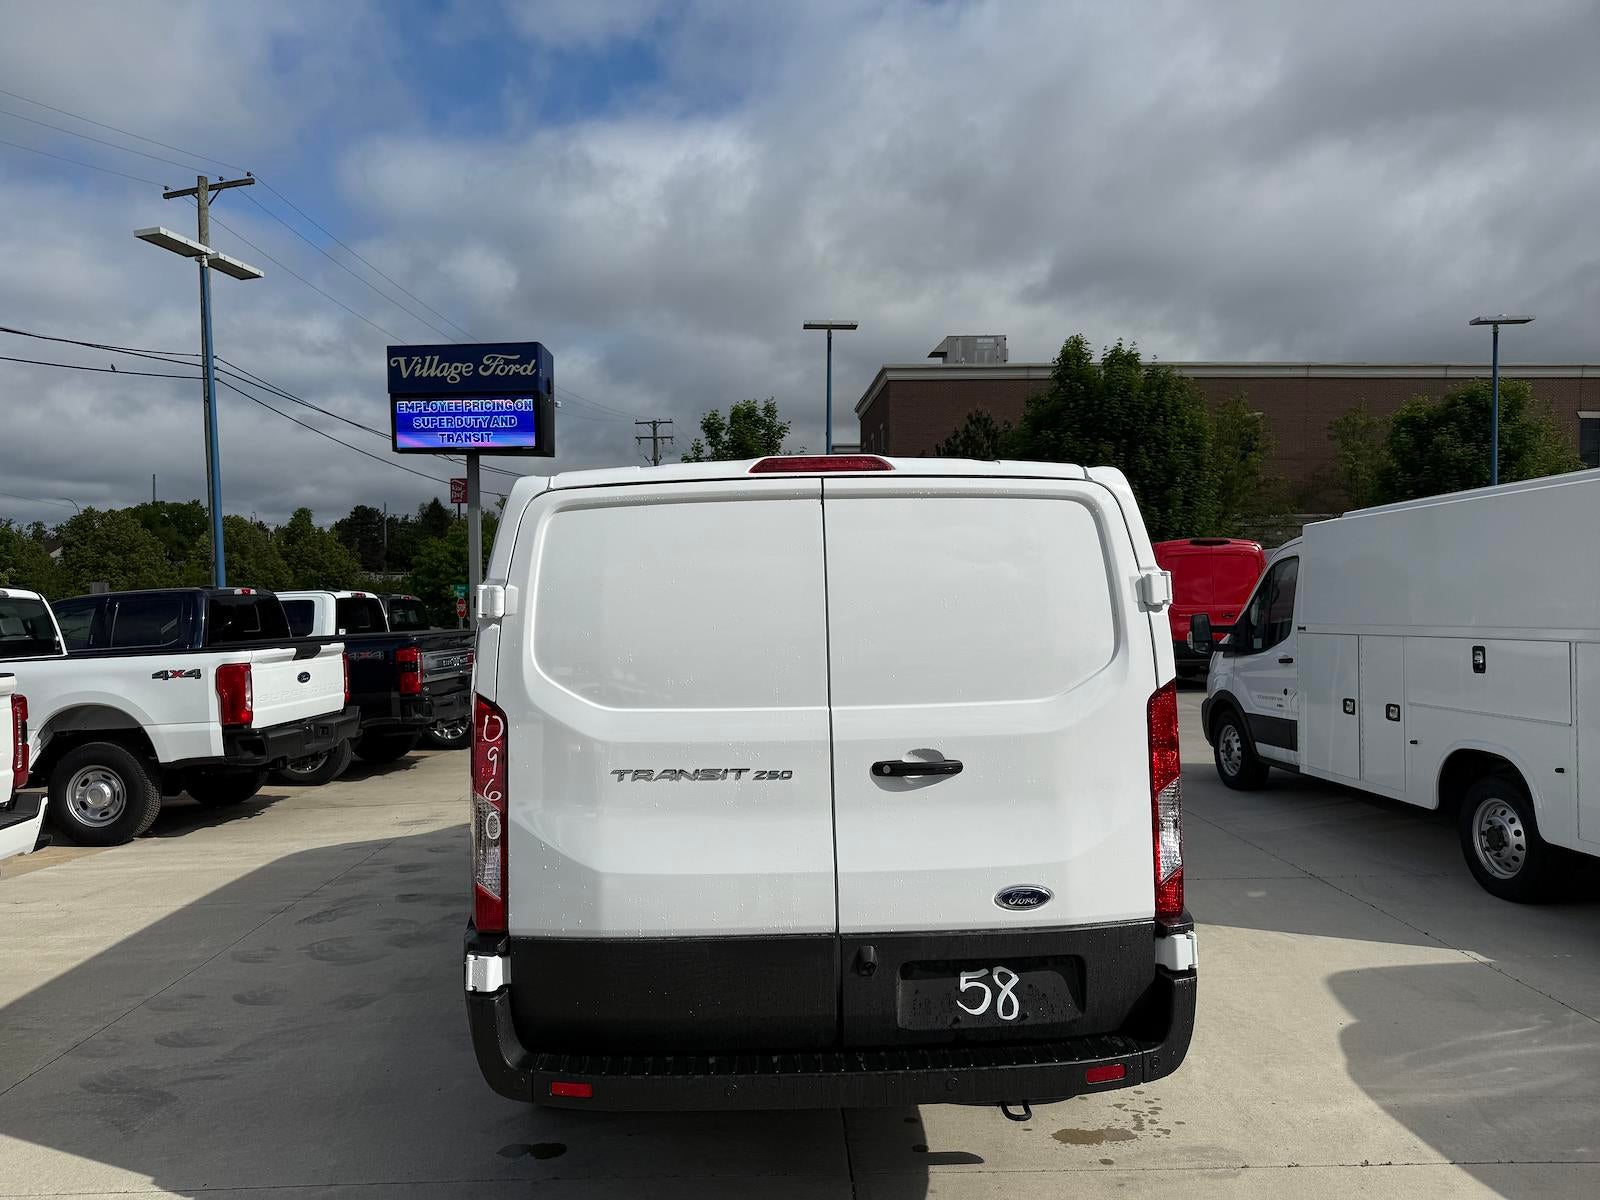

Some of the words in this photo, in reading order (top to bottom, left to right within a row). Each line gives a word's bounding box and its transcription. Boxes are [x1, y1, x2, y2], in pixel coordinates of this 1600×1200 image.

[390, 355, 474, 384] Village
[478, 353, 537, 377] Ford
[396, 400, 462, 413] EMPLOYEE
[465, 399, 513, 412] PRICING
[513, 399, 533, 412] ON
[413, 416, 454, 429] SUPER
[456, 416, 490, 429] DUTY
[490, 415, 517, 428] AND
[438, 432, 493, 443] TRANSIT
[610, 768, 751, 782] TRANSIT
[752, 770, 793, 780] 250
[956, 966, 1020, 1020] 58
